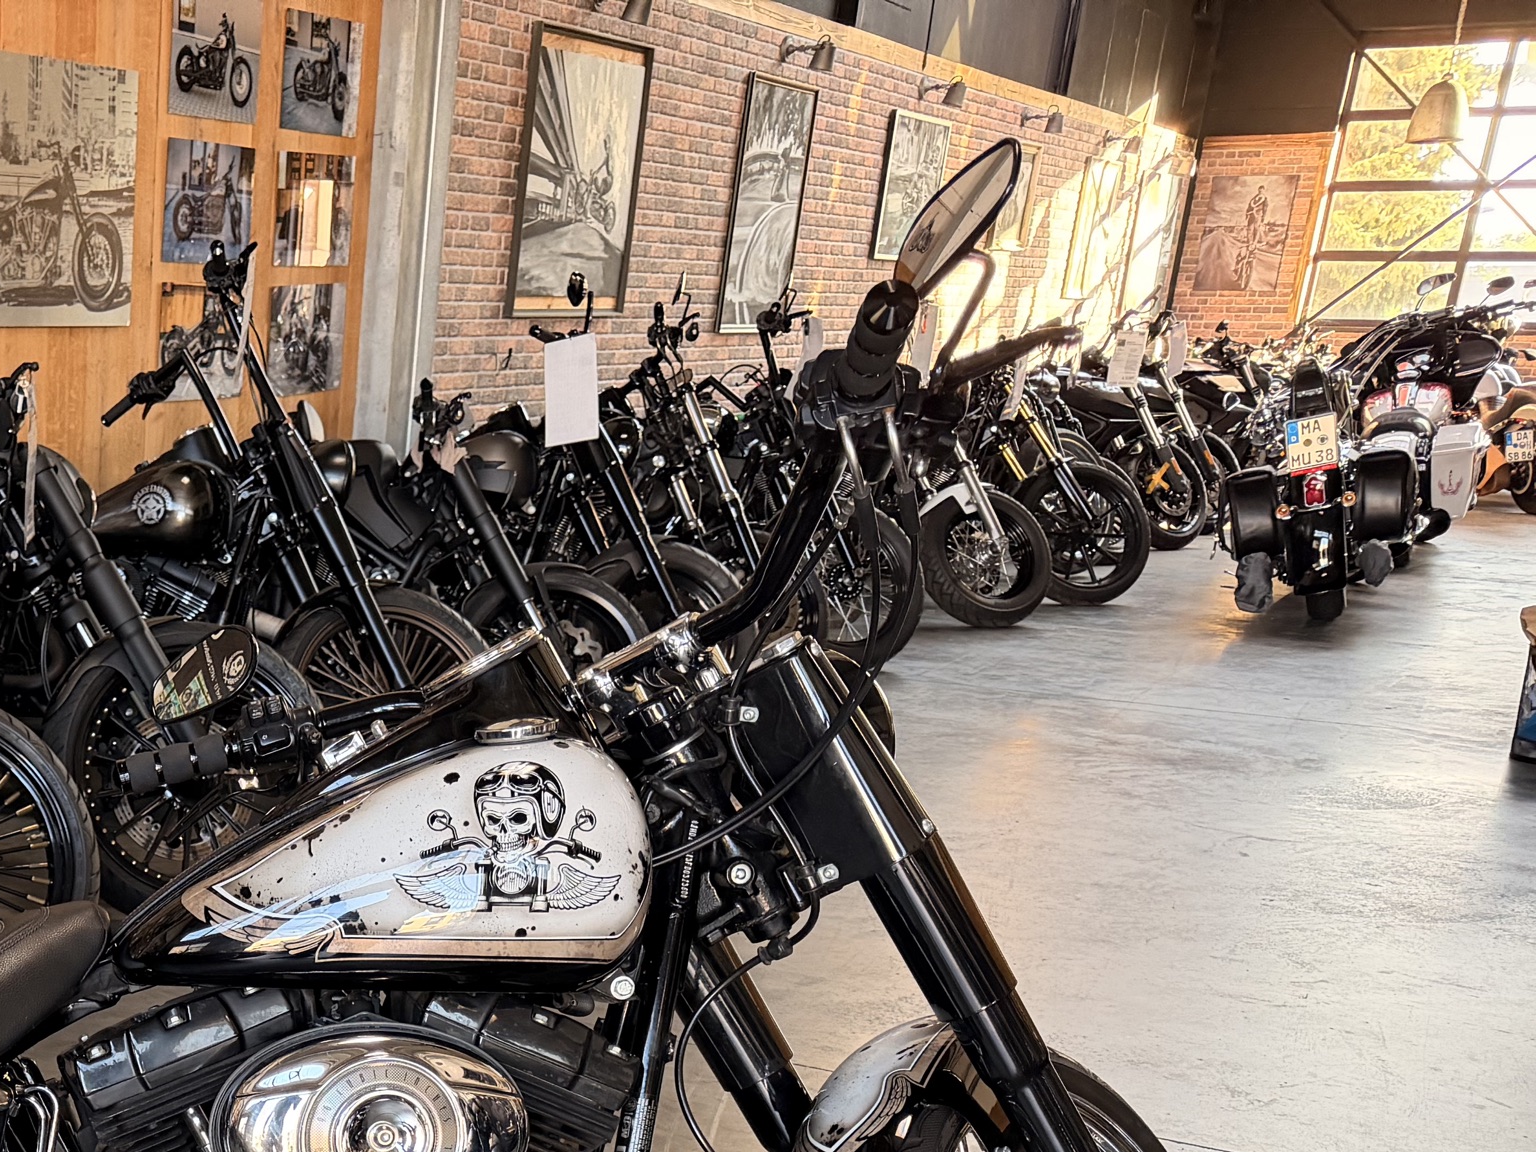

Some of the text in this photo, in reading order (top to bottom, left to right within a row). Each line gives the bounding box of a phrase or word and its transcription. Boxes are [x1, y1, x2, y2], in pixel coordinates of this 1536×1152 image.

[1301, 419, 1321, 435] MA
[1516, 431, 1528, 441] DA
[1291, 448, 1334, 468] MU 38
[1507, 450, 1533, 461] SB 86
